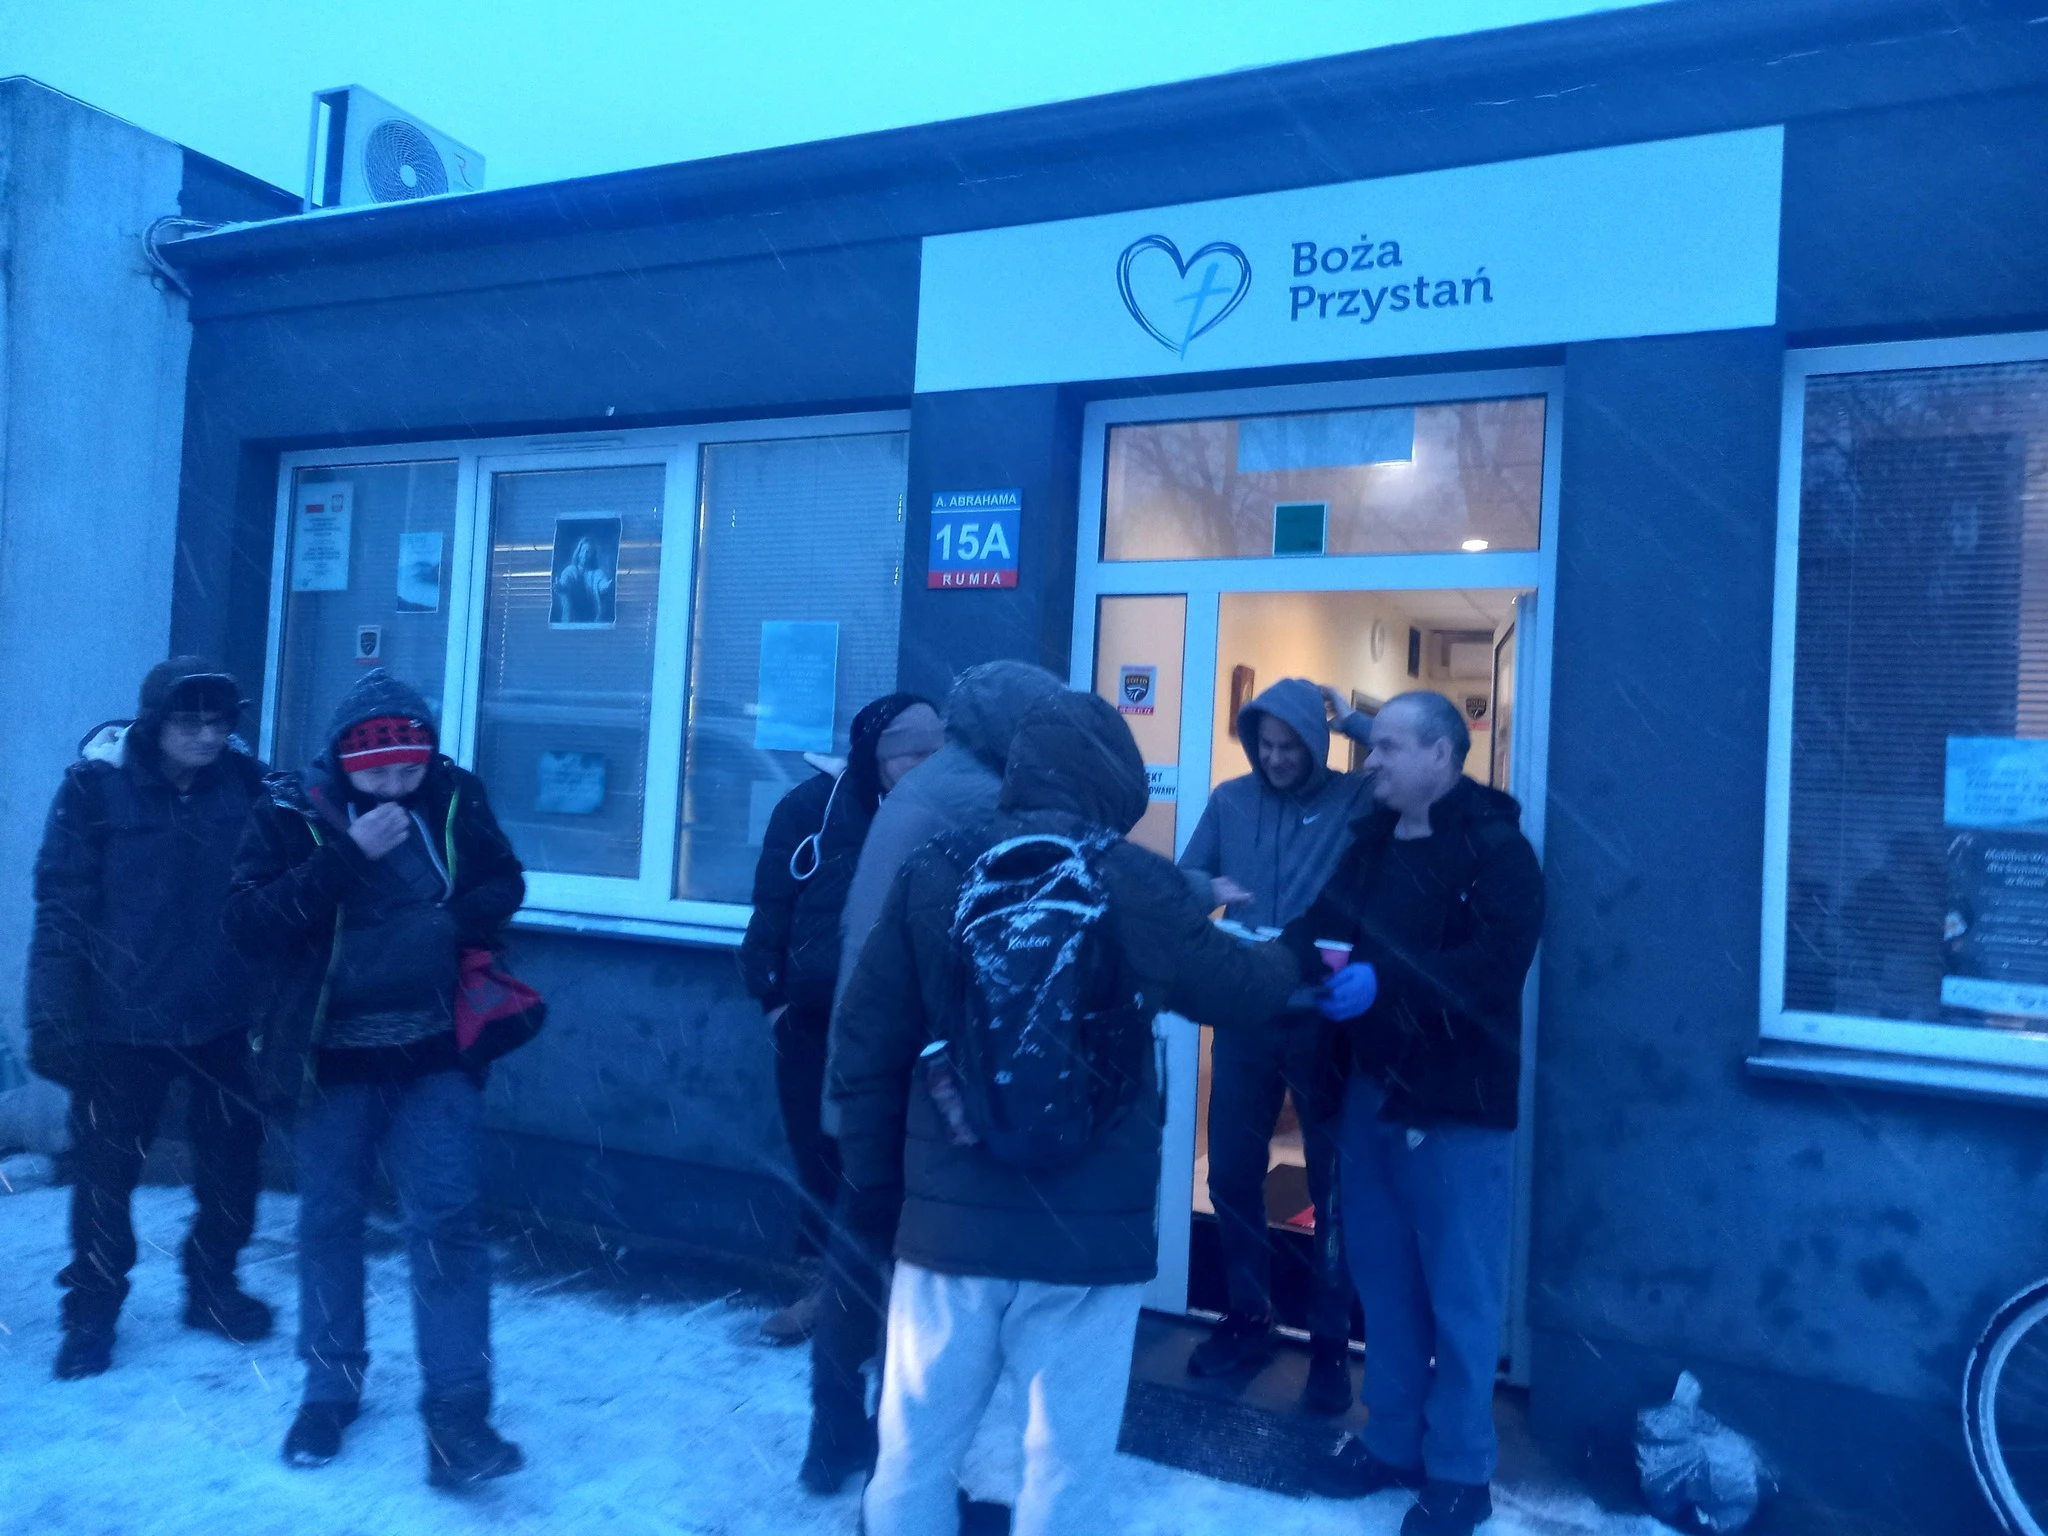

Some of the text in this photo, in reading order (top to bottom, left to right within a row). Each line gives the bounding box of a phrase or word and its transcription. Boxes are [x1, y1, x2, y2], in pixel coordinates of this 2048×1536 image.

[1291, 233, 1403, 278] Boża
[1289, 266, 1494, 325] Przystań
[935, 493, 1017, 508] A. ABRAHAMA
[936, 521, 1011, 561] 15A
[942, 572, 1001, 586] RUMIA
